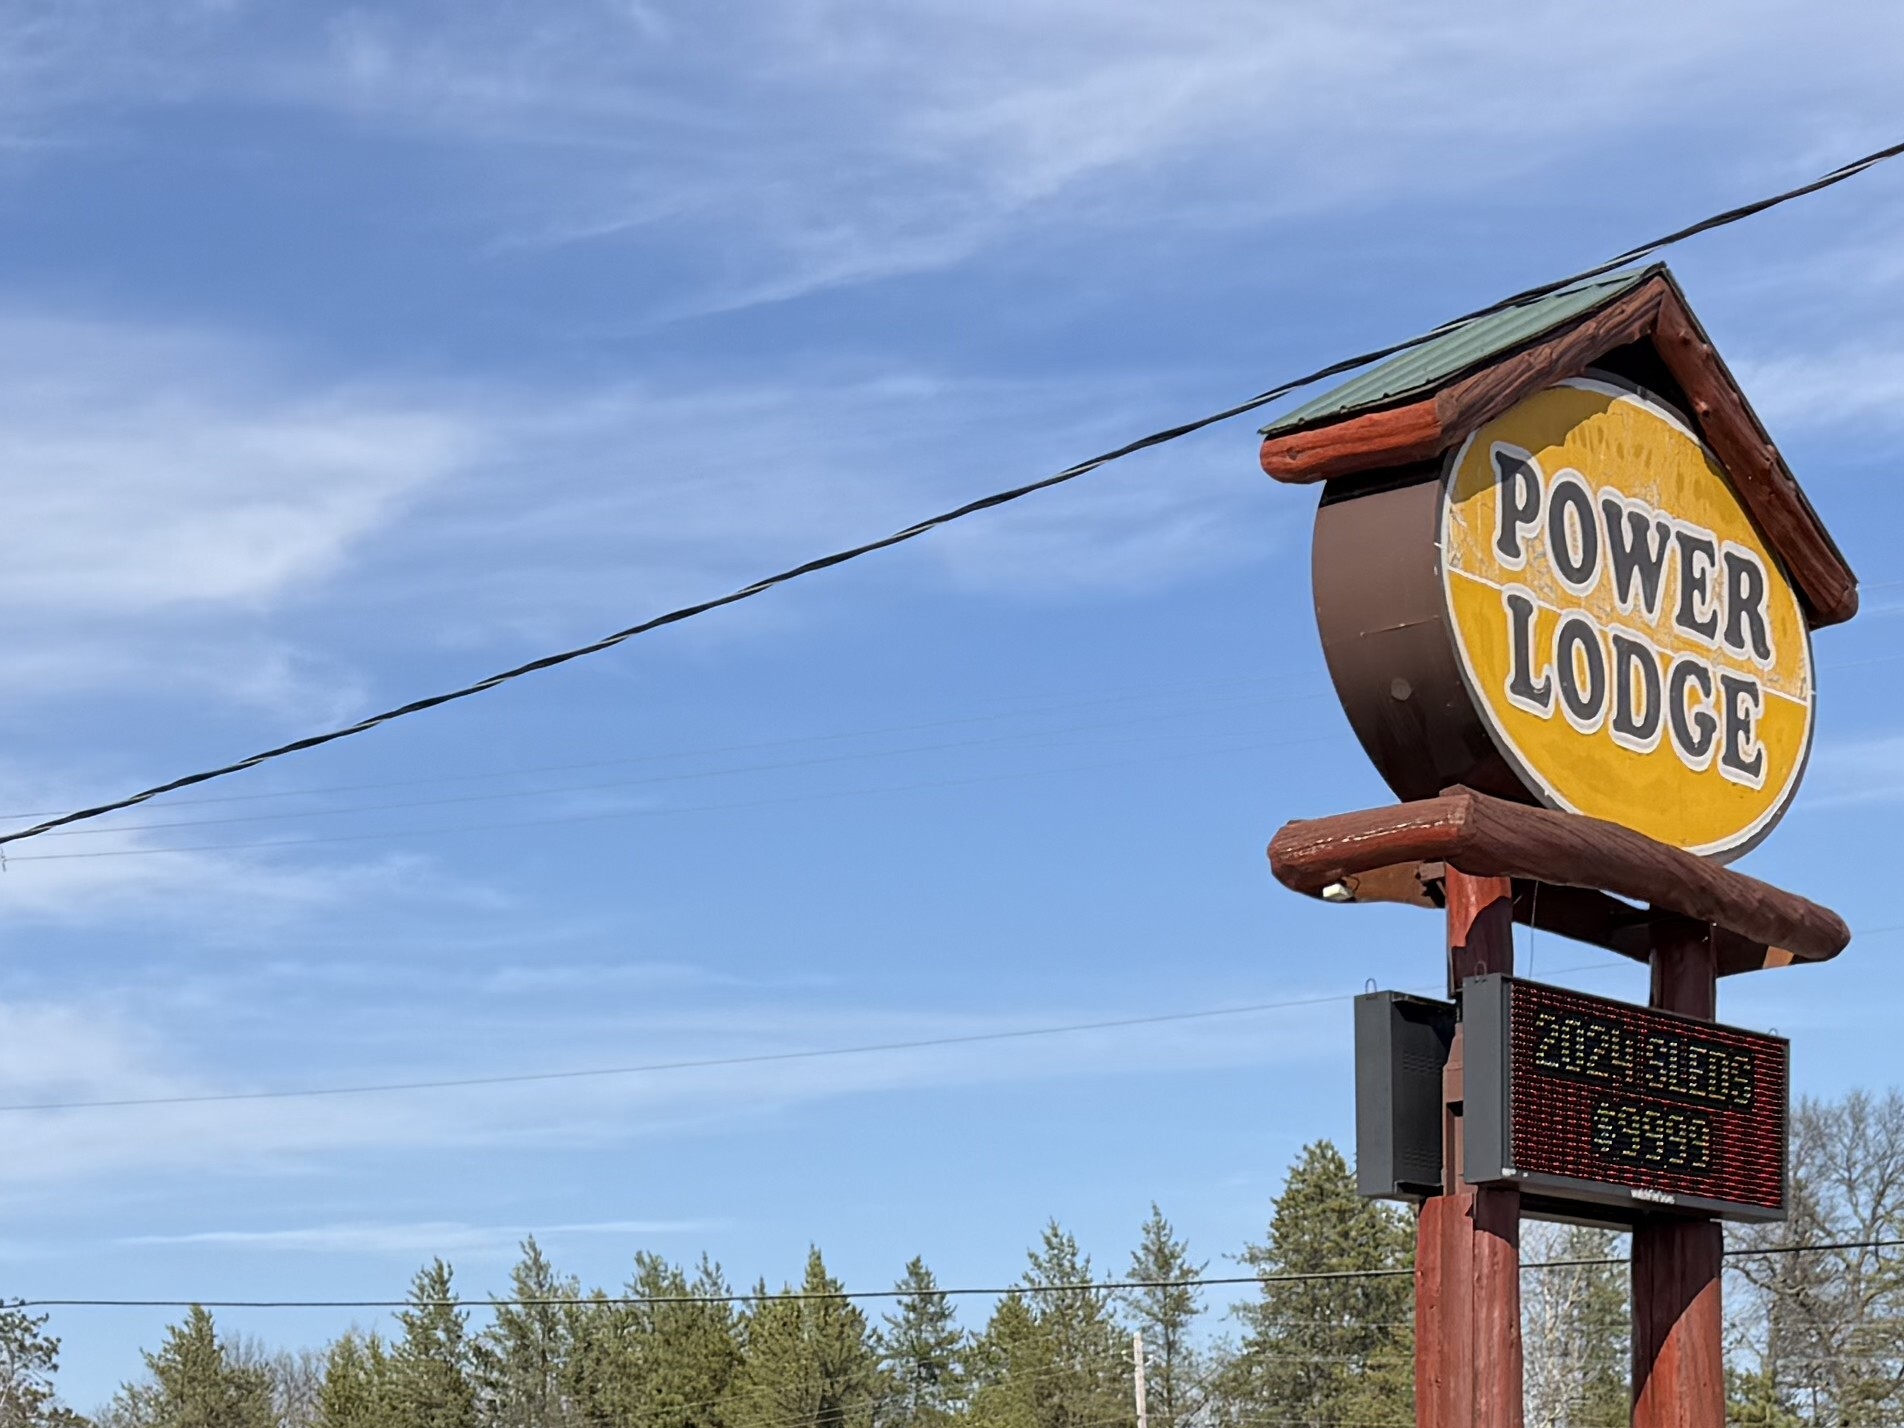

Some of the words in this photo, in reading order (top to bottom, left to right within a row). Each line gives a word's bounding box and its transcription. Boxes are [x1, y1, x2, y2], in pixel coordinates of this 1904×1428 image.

[1493, 447, 1773, 663] POWER
[1505, 591, 1766, 781] LODGE
[1535, 1013, 1634, 1083] 2024
[1646, 1037, 1752, 1105] SLEDS
[1593, 1102, 1710, 1168] $9999
